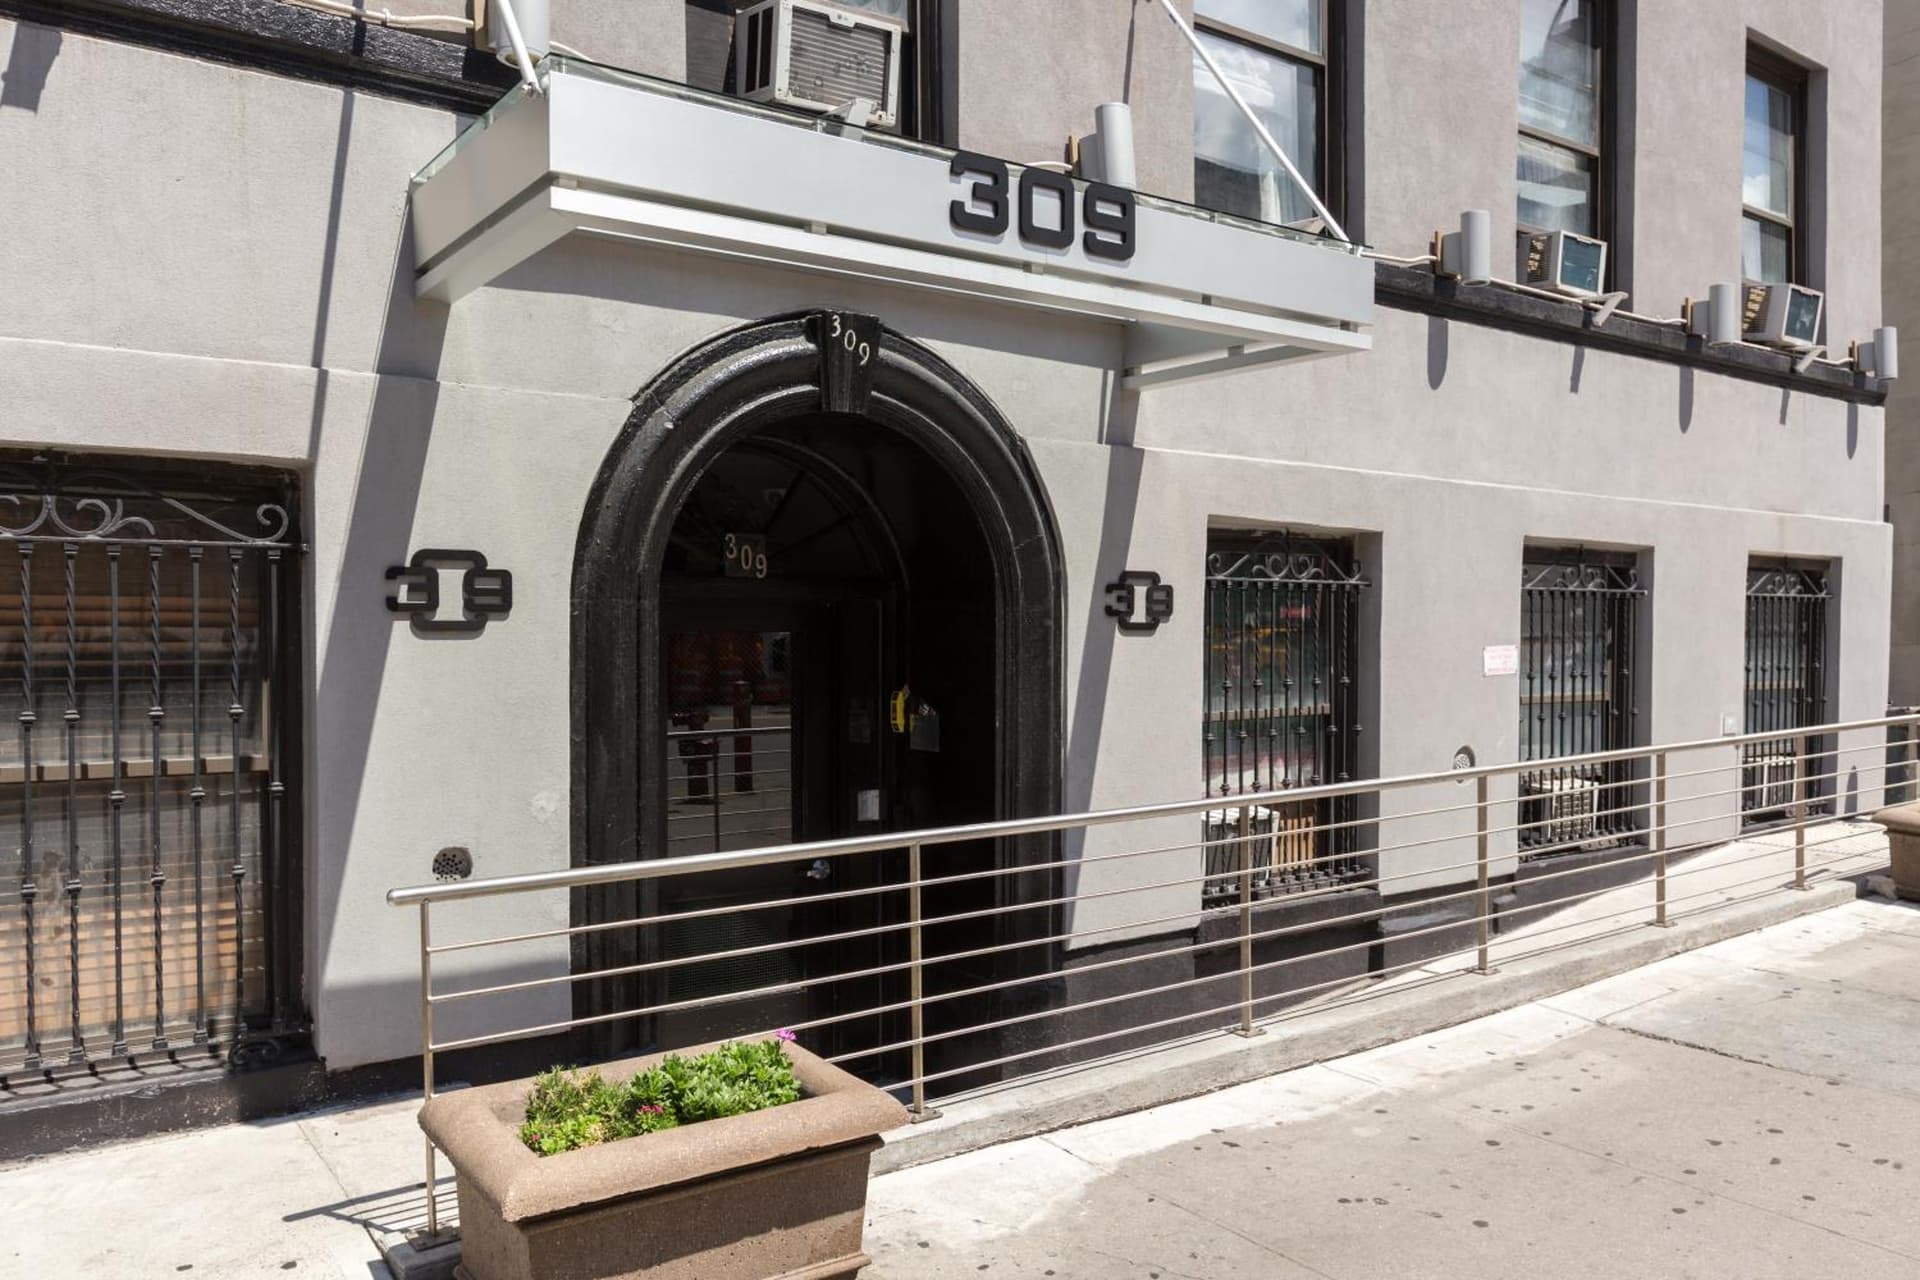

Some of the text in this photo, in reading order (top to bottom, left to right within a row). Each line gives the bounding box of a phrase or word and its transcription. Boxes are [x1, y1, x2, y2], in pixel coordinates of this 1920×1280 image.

[950, 151, 1135, 261] 309
[831, 314, 870, 366] 309
[724, 533, 767, 578] 309
[385, 548, 512, 633] 309
